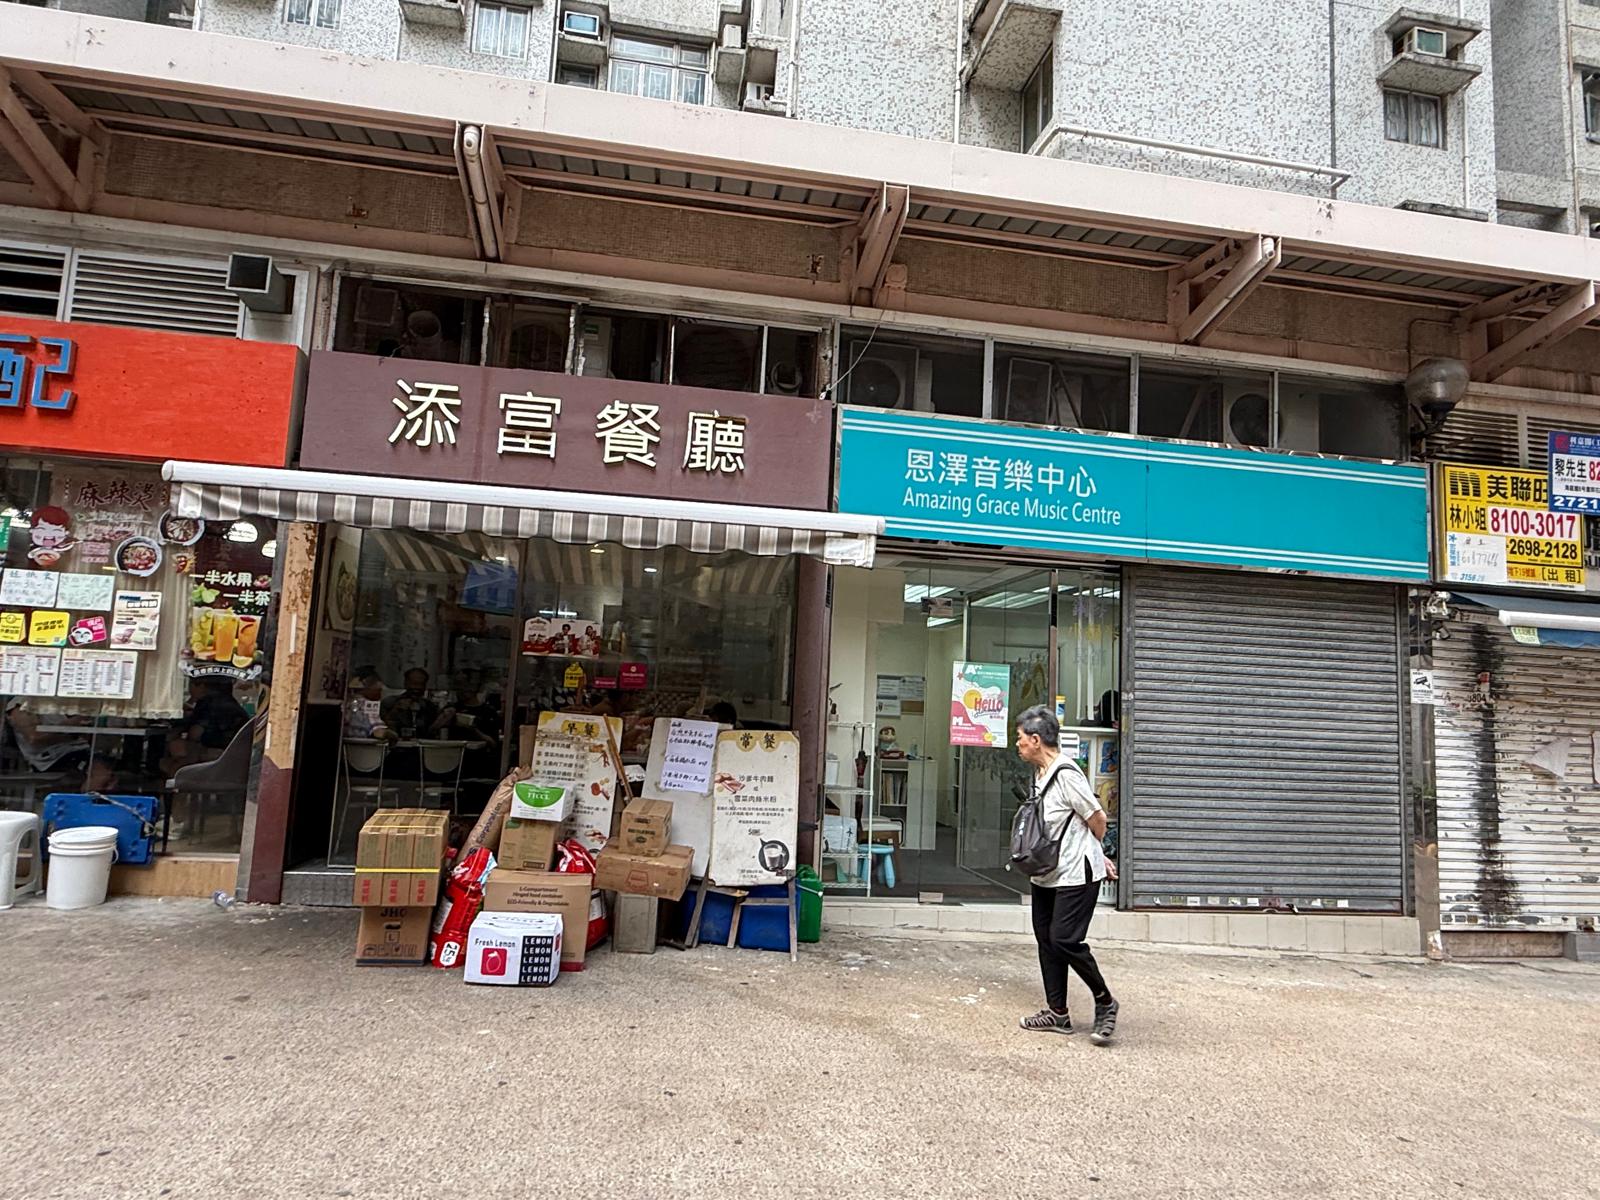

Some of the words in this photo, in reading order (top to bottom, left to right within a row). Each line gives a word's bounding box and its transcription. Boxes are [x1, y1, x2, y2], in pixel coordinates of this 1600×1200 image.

[387, 377, 747, 474] 添富餐廳
[904, 447, 1098, 498] 恩澤音樂中心
[1554, 458, 1588, 479] 黎先生
[902, 486, 972, 518] Amazing
[975, 492, 1021, 517] Grace
[1023, 497, 1069, 521] Music
[1071, 501, 1122, 526] Centre
[1553, 495, 1599, 510] 2721
[1449, 503, 1488, 531] 林小姐
[1490, 507, 1576, 539] 8100-3017
[189, 569, 254, 588] 一半水果
[223, 590, 272, 607] 一半茶
[739, 732, 777, 750] 常餐
[474, 801, 504, 844] Corporation
[475, 938, 494, 946] Fresh
[495, 938, 516, 948] Lemon
[525, 937, 552, 945] LEMON
[524, 947, 551, 955] LEMON
[523, 956, 550, 964] LEMON
[522, 965, 549, 973] LEMON
[521, 975, 548, 983] LEMON
